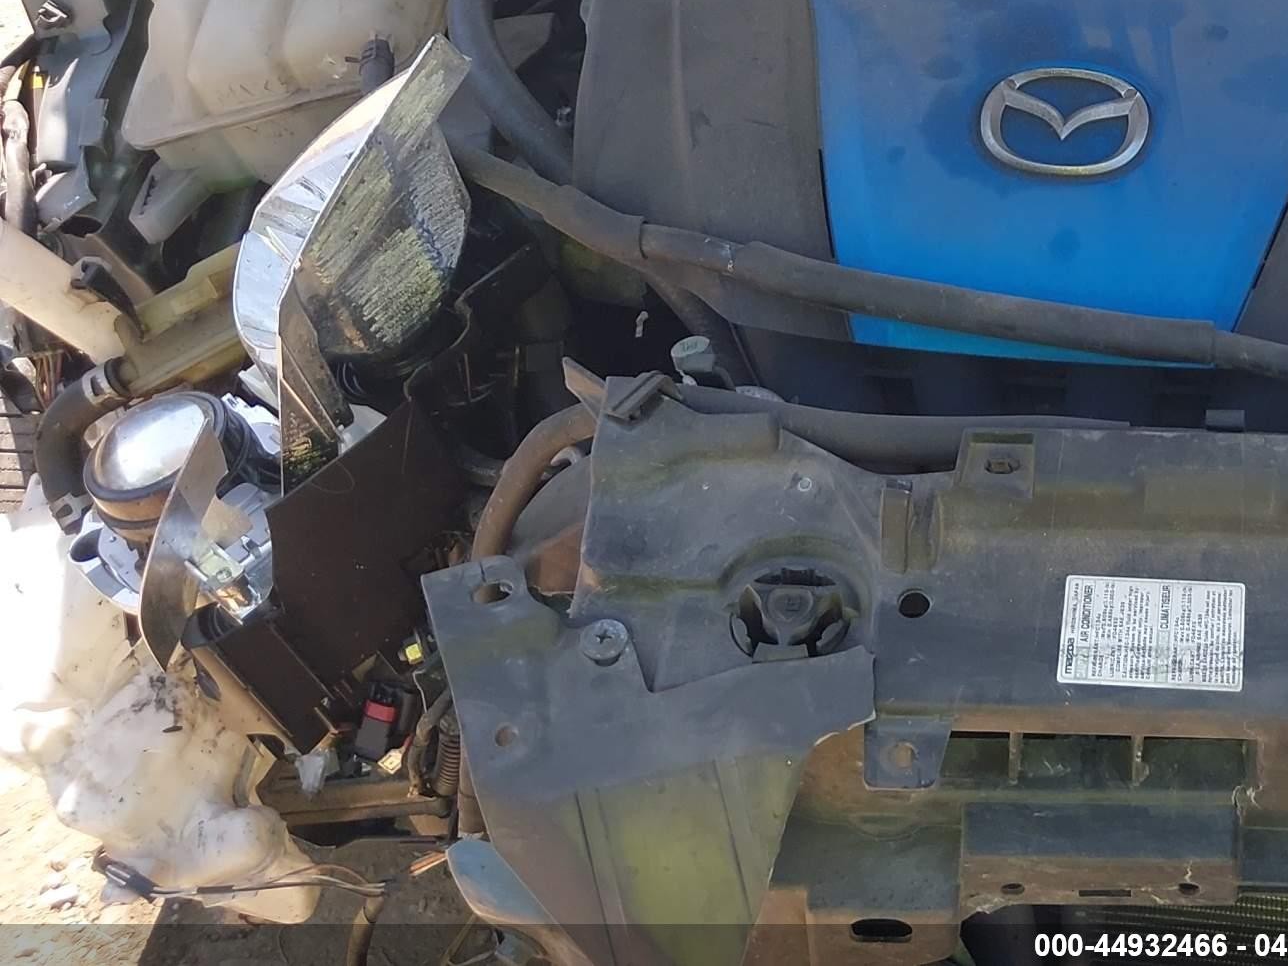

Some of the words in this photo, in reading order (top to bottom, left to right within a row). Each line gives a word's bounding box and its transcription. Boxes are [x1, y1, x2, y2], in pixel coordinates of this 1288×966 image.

[1080, 584, 1092, 629] CONDITIONER
[1159, 584, 1171, 629] CLIMATISEUR
[1064, 637, 1075, 674] mazda
[1079, 630, 1089, 642] AIR
